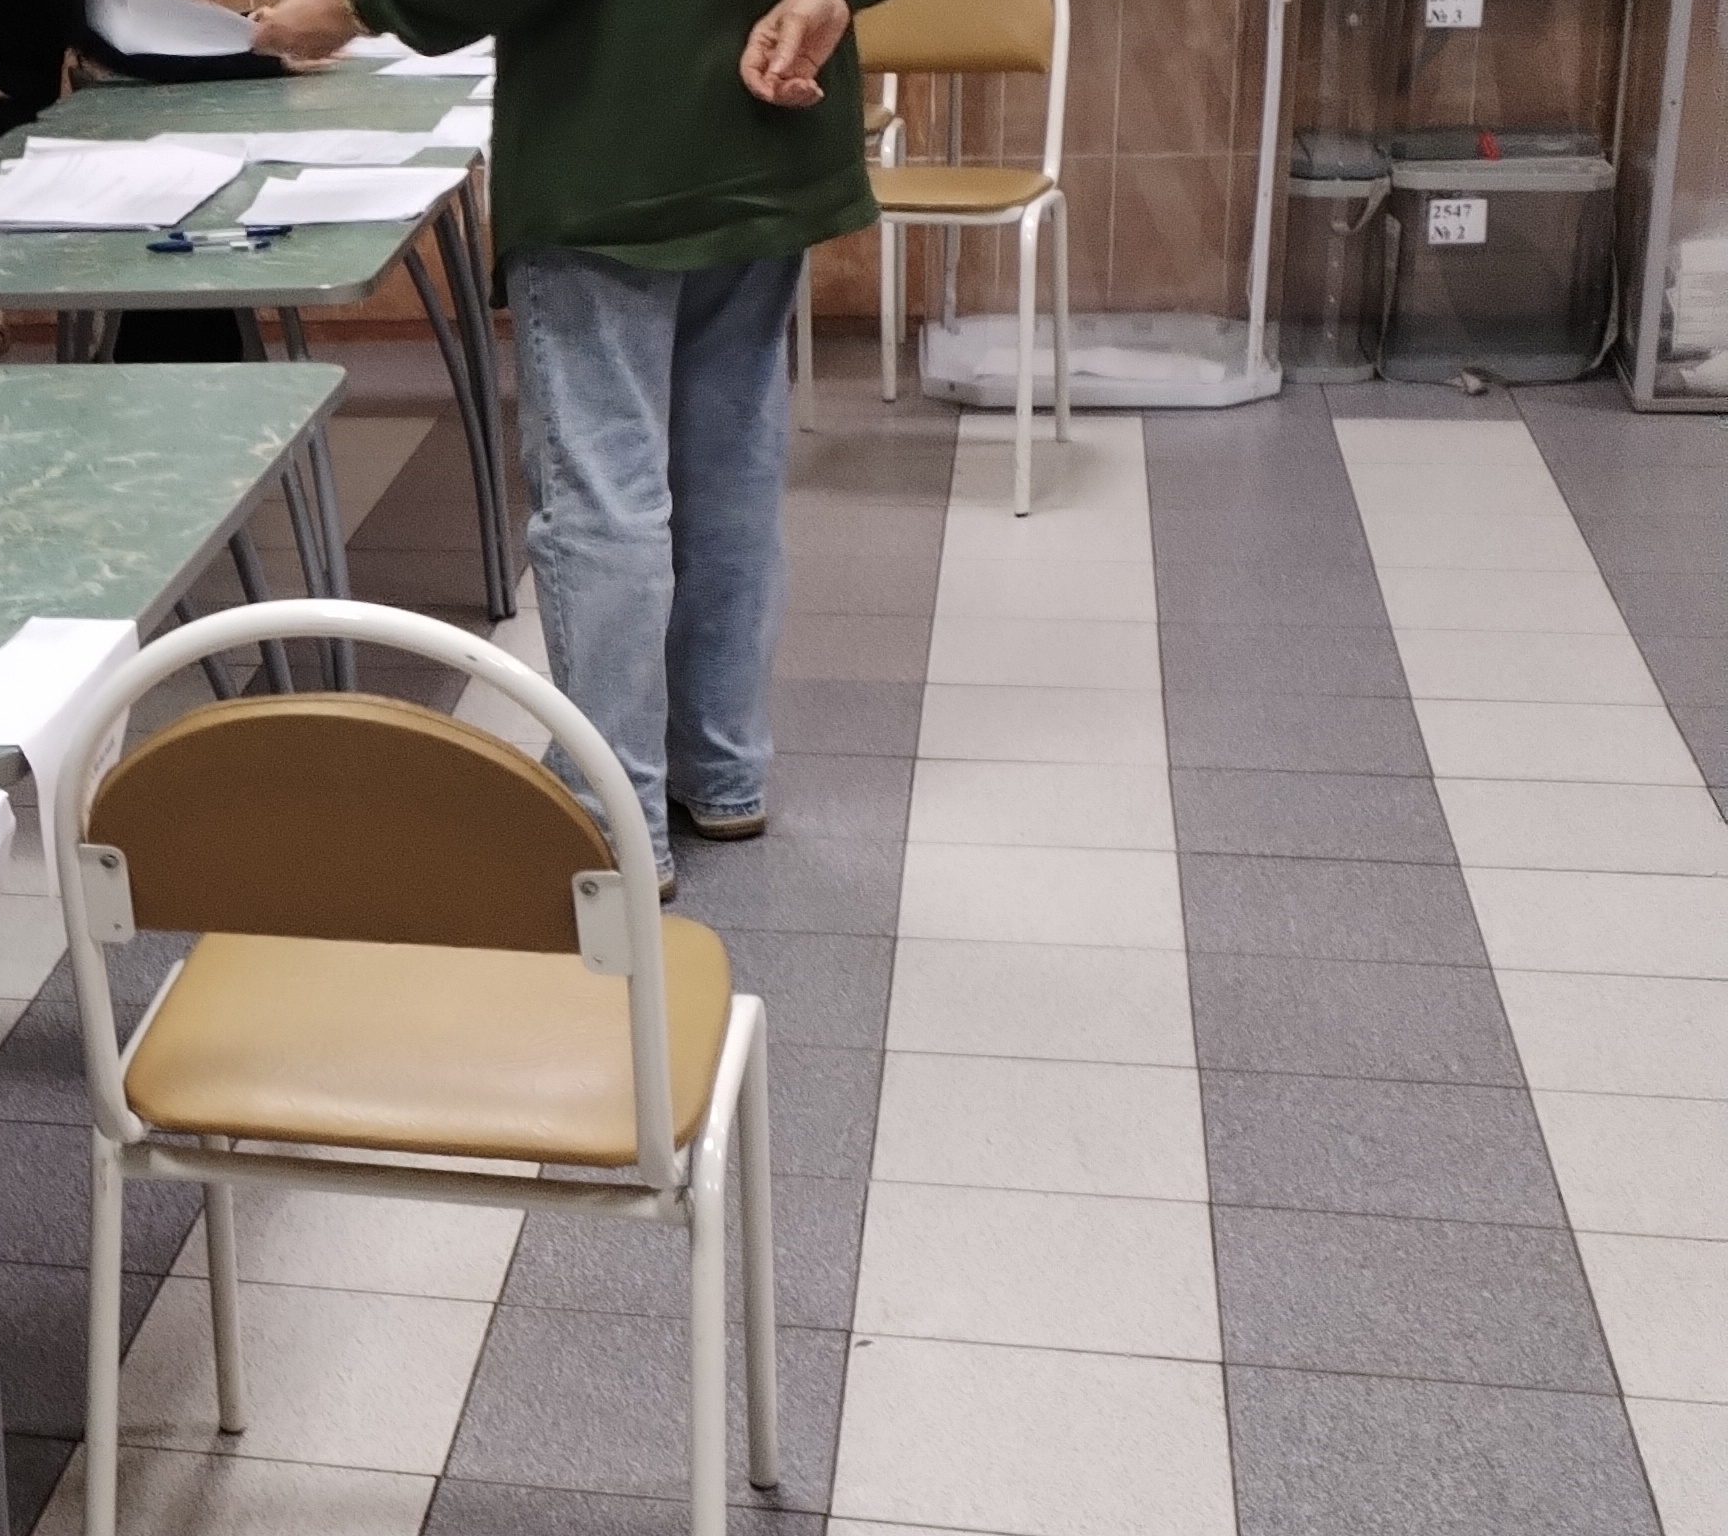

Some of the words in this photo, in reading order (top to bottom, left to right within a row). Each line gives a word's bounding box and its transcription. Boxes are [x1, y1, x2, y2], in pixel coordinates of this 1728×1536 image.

[1427, 9, 1448, 24] №
[1453, 9, 1463, 24] 3
[1432, 203, 1472, 219] 2547
[1431, 225, 1451, 240] №
[1457, 225, 1466, 240] 2
